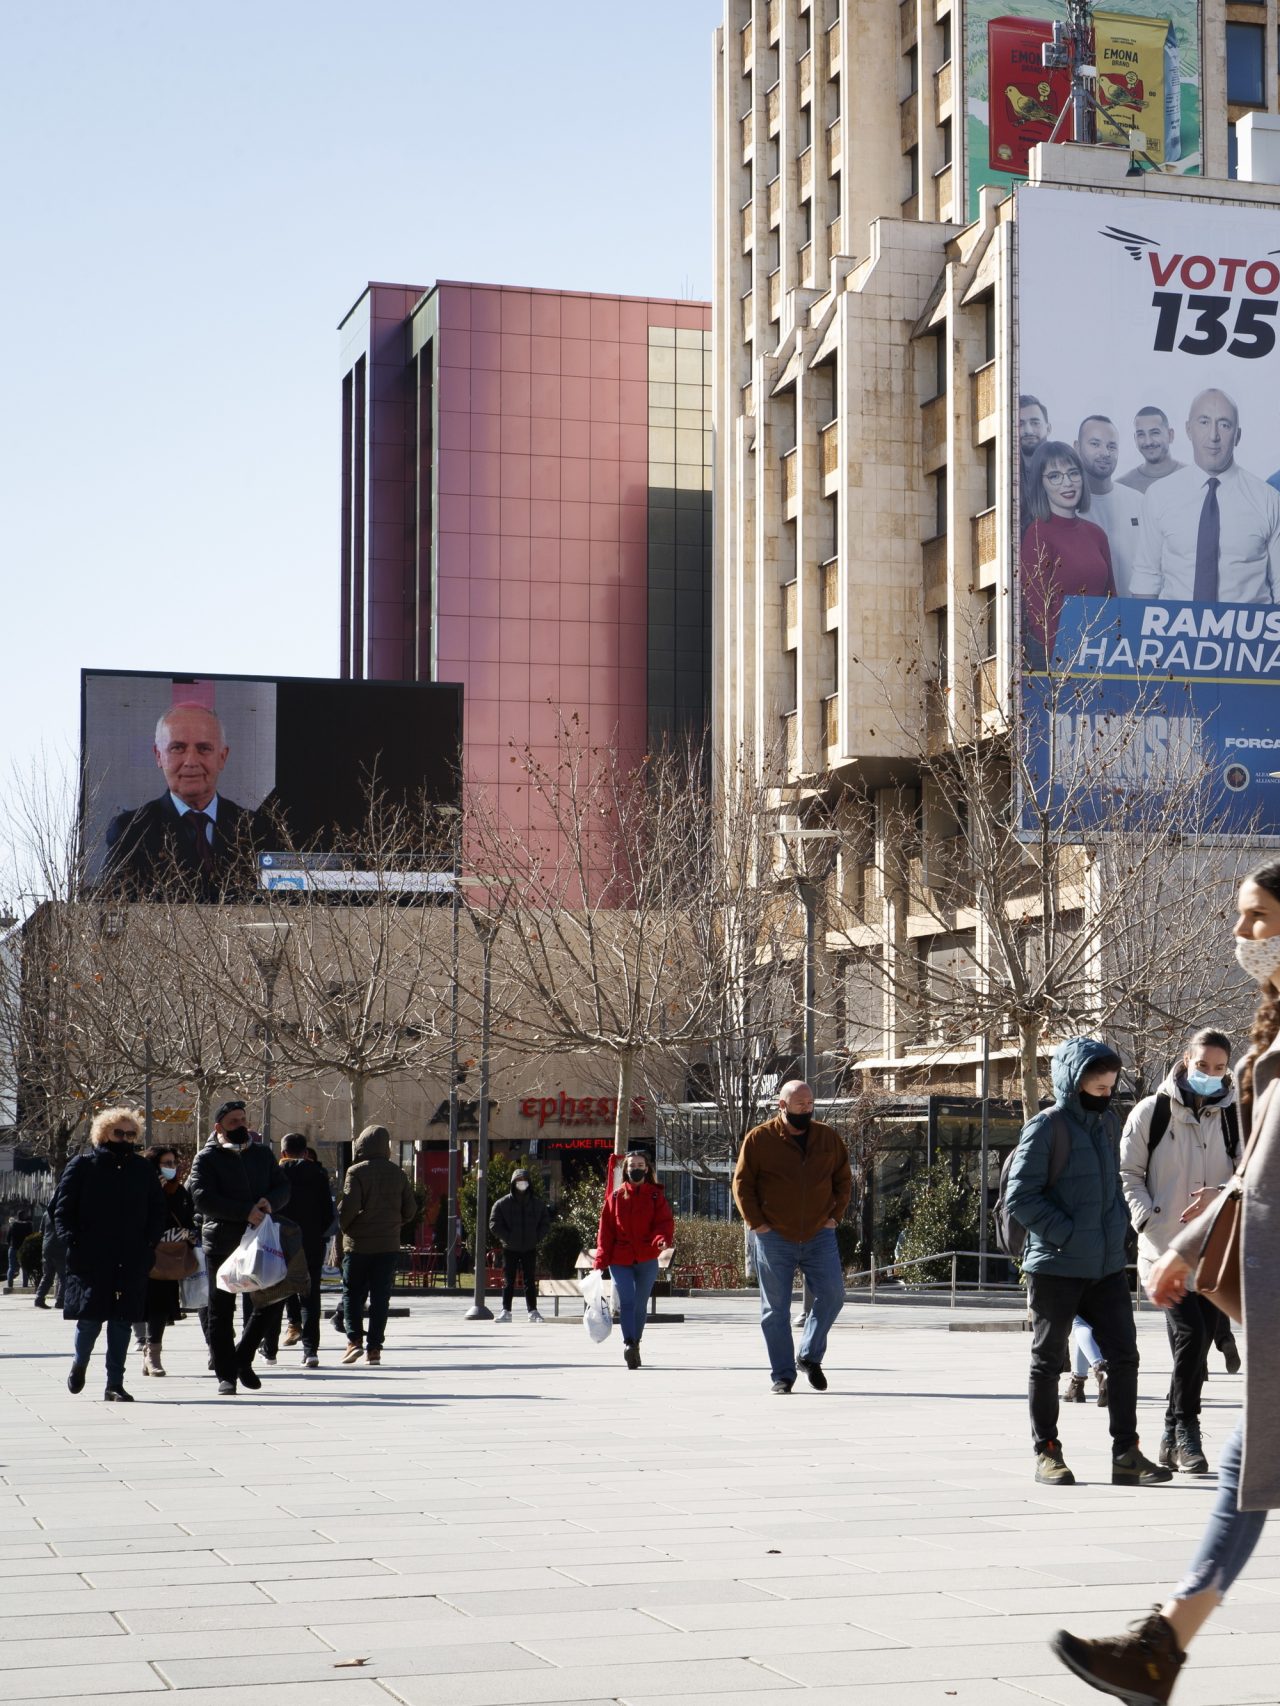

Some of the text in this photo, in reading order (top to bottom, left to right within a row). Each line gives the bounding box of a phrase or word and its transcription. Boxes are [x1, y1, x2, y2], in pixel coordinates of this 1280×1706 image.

[1103, 48, 1139, 64] EMONA
[1148, 251, 1280, 295] VOTO
[1151, 291, 1279, 359] 135
[521, 1090, 646, 1128] ephess
